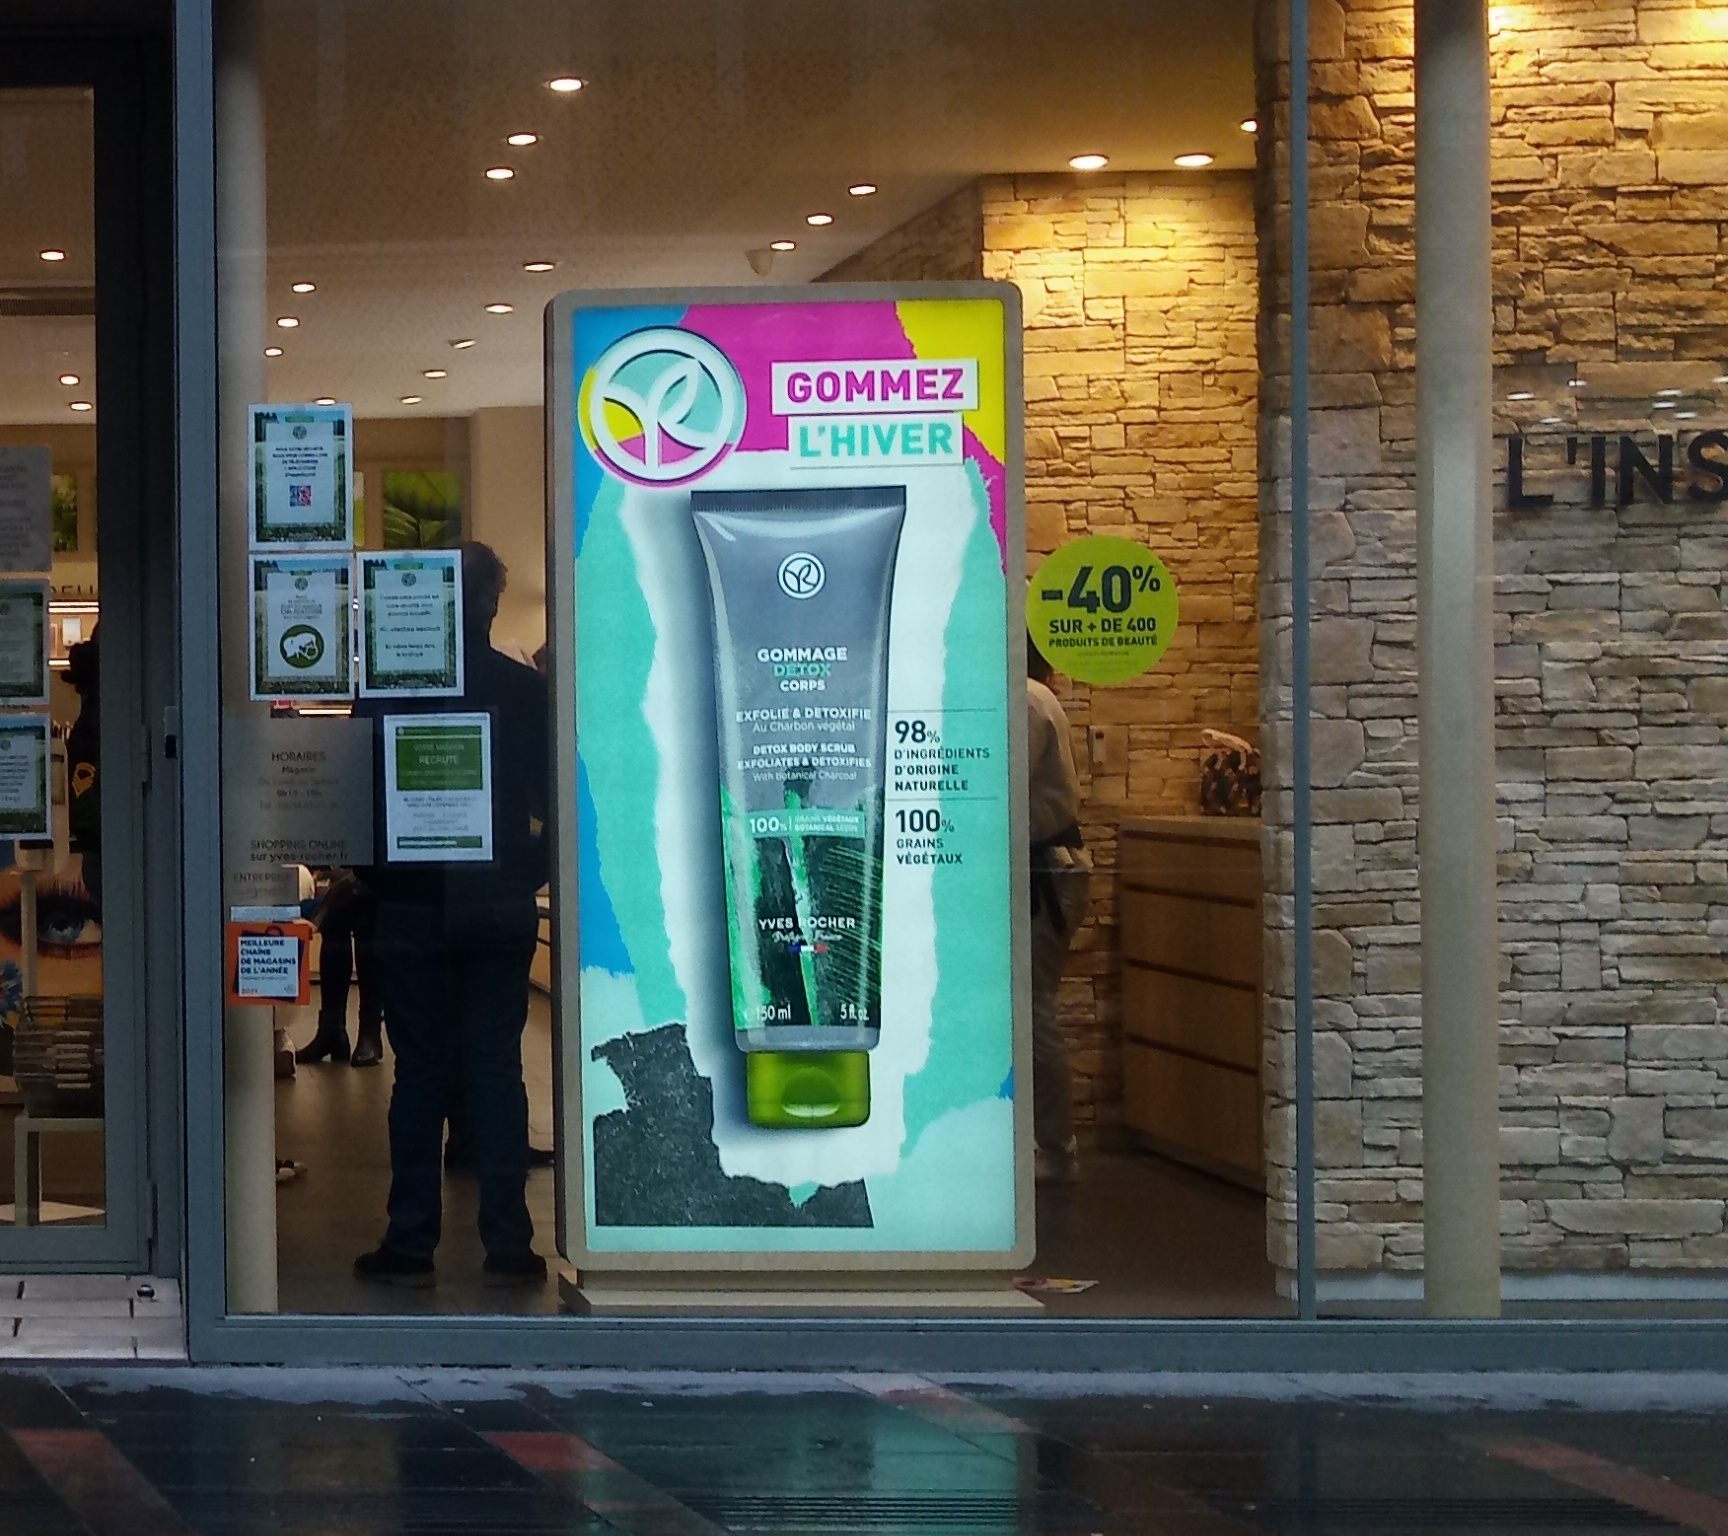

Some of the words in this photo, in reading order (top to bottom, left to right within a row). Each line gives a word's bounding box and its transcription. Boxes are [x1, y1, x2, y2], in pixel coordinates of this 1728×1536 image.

[787, 368, 965, 404] GOMMEZ
[799, 422, 954, 459] L'HIVER
[1041, 565, 1161, 614] -40%
[1049, 619, 1083, 634] SUR
[1101, 618, 1123, 633] DE
[1126, 617, 1157, 632] 400
[1048, 637, 1099, 648] PRODUITS
[1101, 637, 1115, 646] DE
[1117, 634, 1158, 646] BEAUTÉ
[757, 647, 848, 662] GOMMAGE
[774, 663, 831, 677] DETOX
[780, 680, 826, 692] CORPS
[752, 723, 767, 733] Au
[769, 721, 814, 732] Charbon
[817, 721, 856, 733] végétal
[894, 720, 941, 744] 98%
[753, 744, 787, 755] DETOX
[789, 744, 818, 754] BODY
[821, 743, 856, 754] SCRUB
[894, 746, 990, 760] D'INGRÉDIENTS
[271, 750, 327, 762] HORAIRES
[894, 764, 959, 776] D'ORIGINE
[894, 779, 969, 792] NATURELLE
[895, 809, 955, 833] 100%
[250, 839, 306, 850] SHOPPING
[308, 839, 347, 850] ONLINE
[896, 838, 944, 849] GRAINS
[250, 852, 267, 862] sur
[896, 851, 963, 865] VÉGÉTAUX
[758, 917, 794, 930] YVES
[240, 957, 251, 965] DE
[253, 957, 297, 965] MAGASINS
[253, 965, 289, 974] L'ANNÉE
